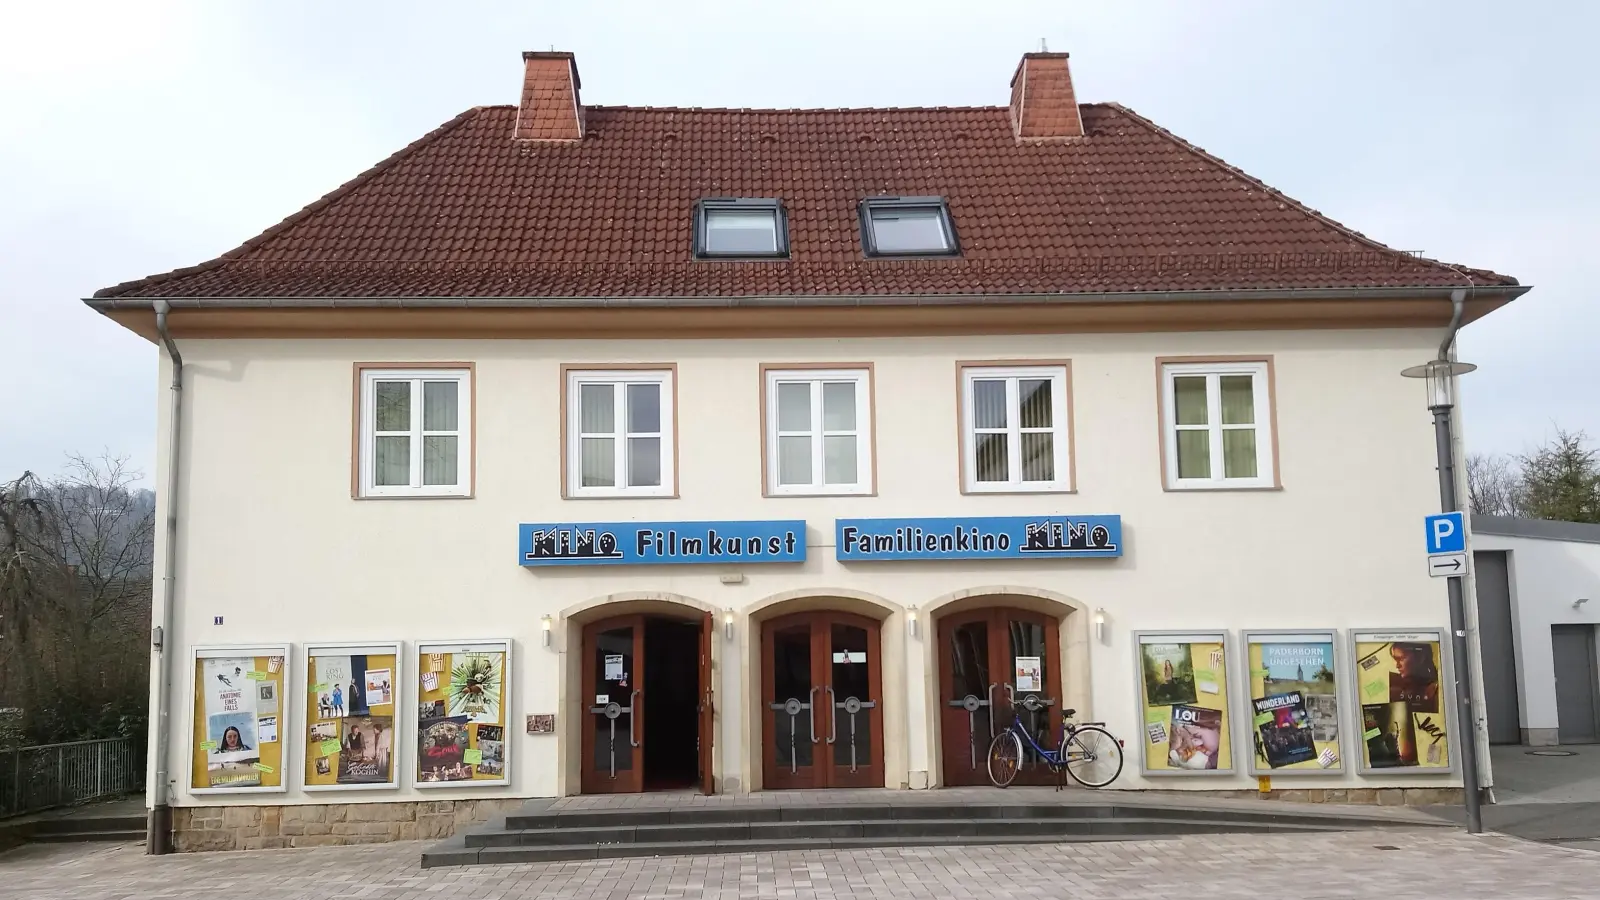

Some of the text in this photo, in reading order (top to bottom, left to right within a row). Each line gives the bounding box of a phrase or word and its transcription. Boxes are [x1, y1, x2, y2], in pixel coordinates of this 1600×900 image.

[843, 519, 1115, 554] Familienkino KINO
[1433, 518, 1455, 549] P
[527, 526, 797, 558] KINO Filmkunst
[1269, 647, 1324, 656] PADERBORN
[1269, 657, 1325, 666] UNGESEHEN
[1256, 694, 1301, 710] WUNDERLAND
[1175, 709, 1201, 723] LOU
